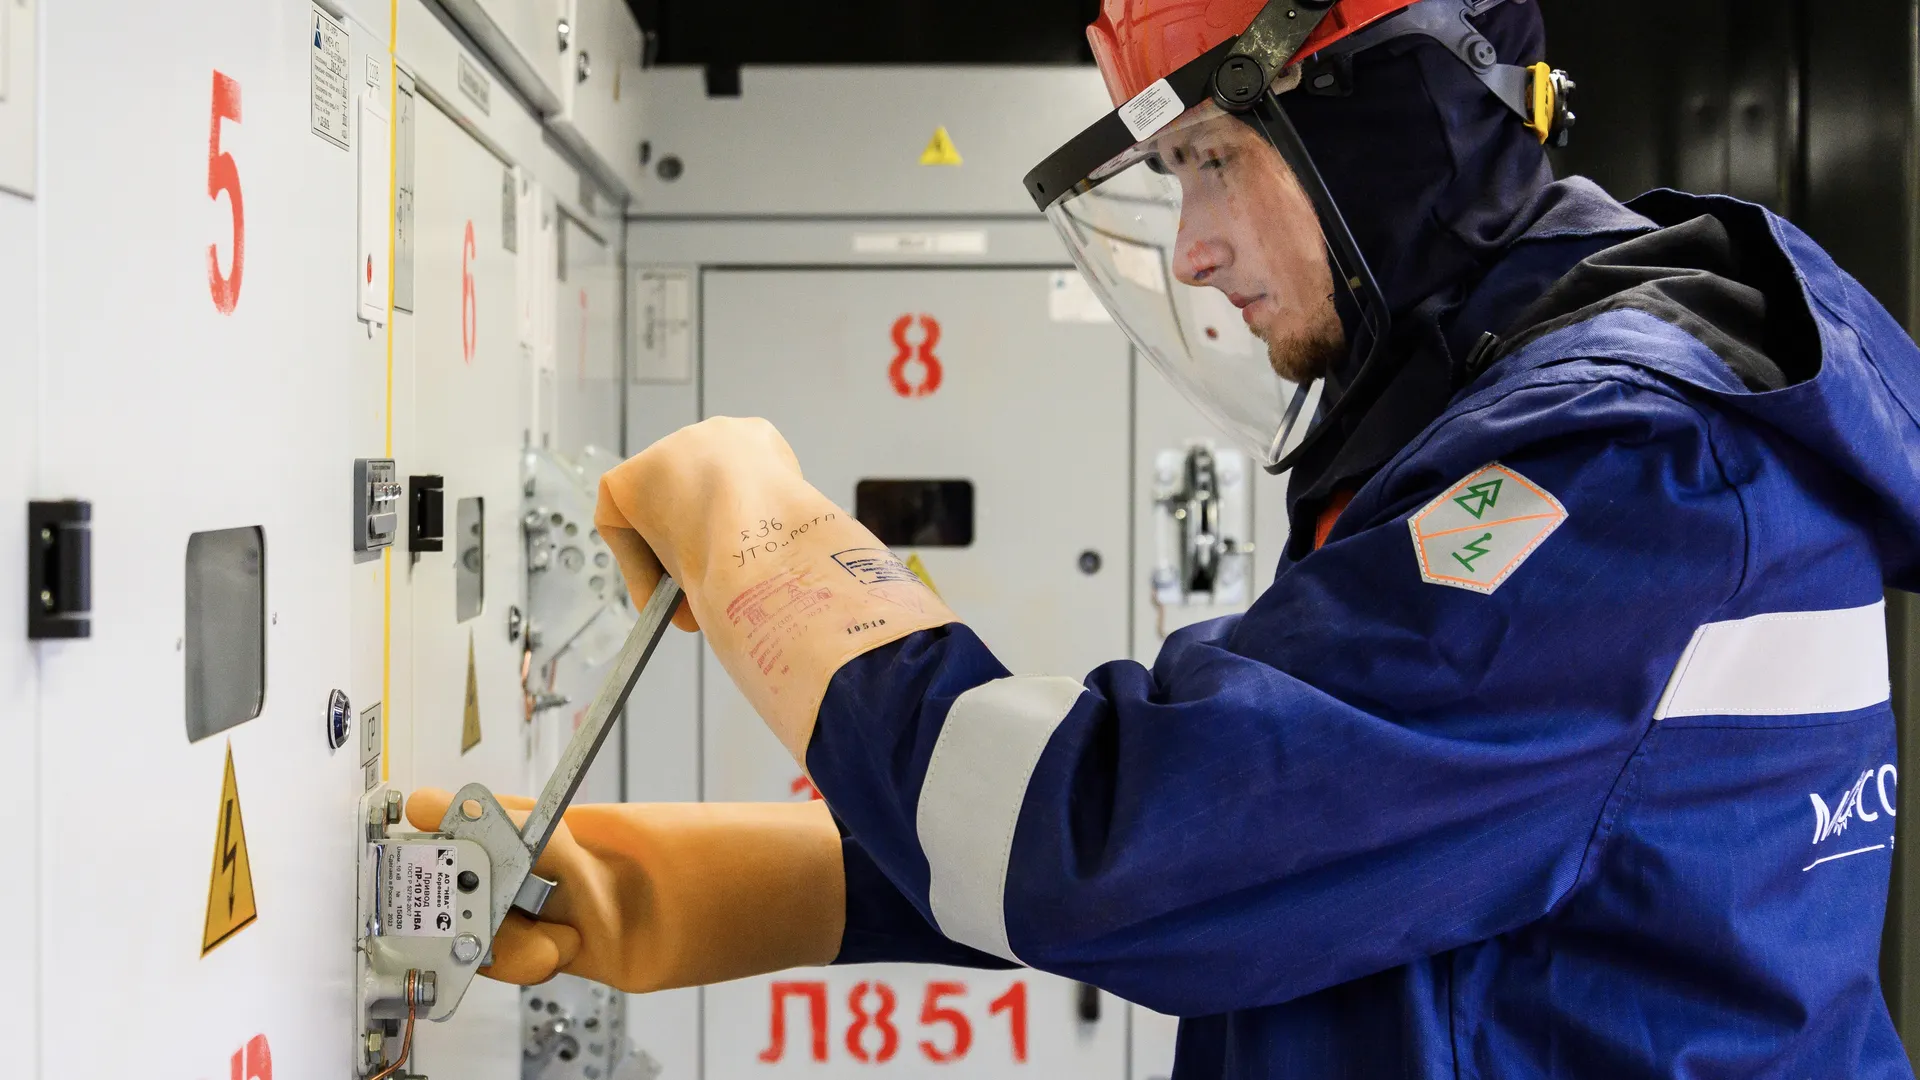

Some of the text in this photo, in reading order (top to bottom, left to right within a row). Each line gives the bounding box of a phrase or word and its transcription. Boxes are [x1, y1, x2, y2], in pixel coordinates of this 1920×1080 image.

[207, 69, 244, 316] 5
[462, 219, 475, 364] 6
[888, 313, 942, 398] 8
[756, 517, 783, 538] 36
[414, 867, 422, 893] ПР-10
[423, 873, 432, 907] Привод
[444, 874, 450, 884] АО
[414, 896, 421, 907] У2
[759, 980, 1026, 1063] Л851
